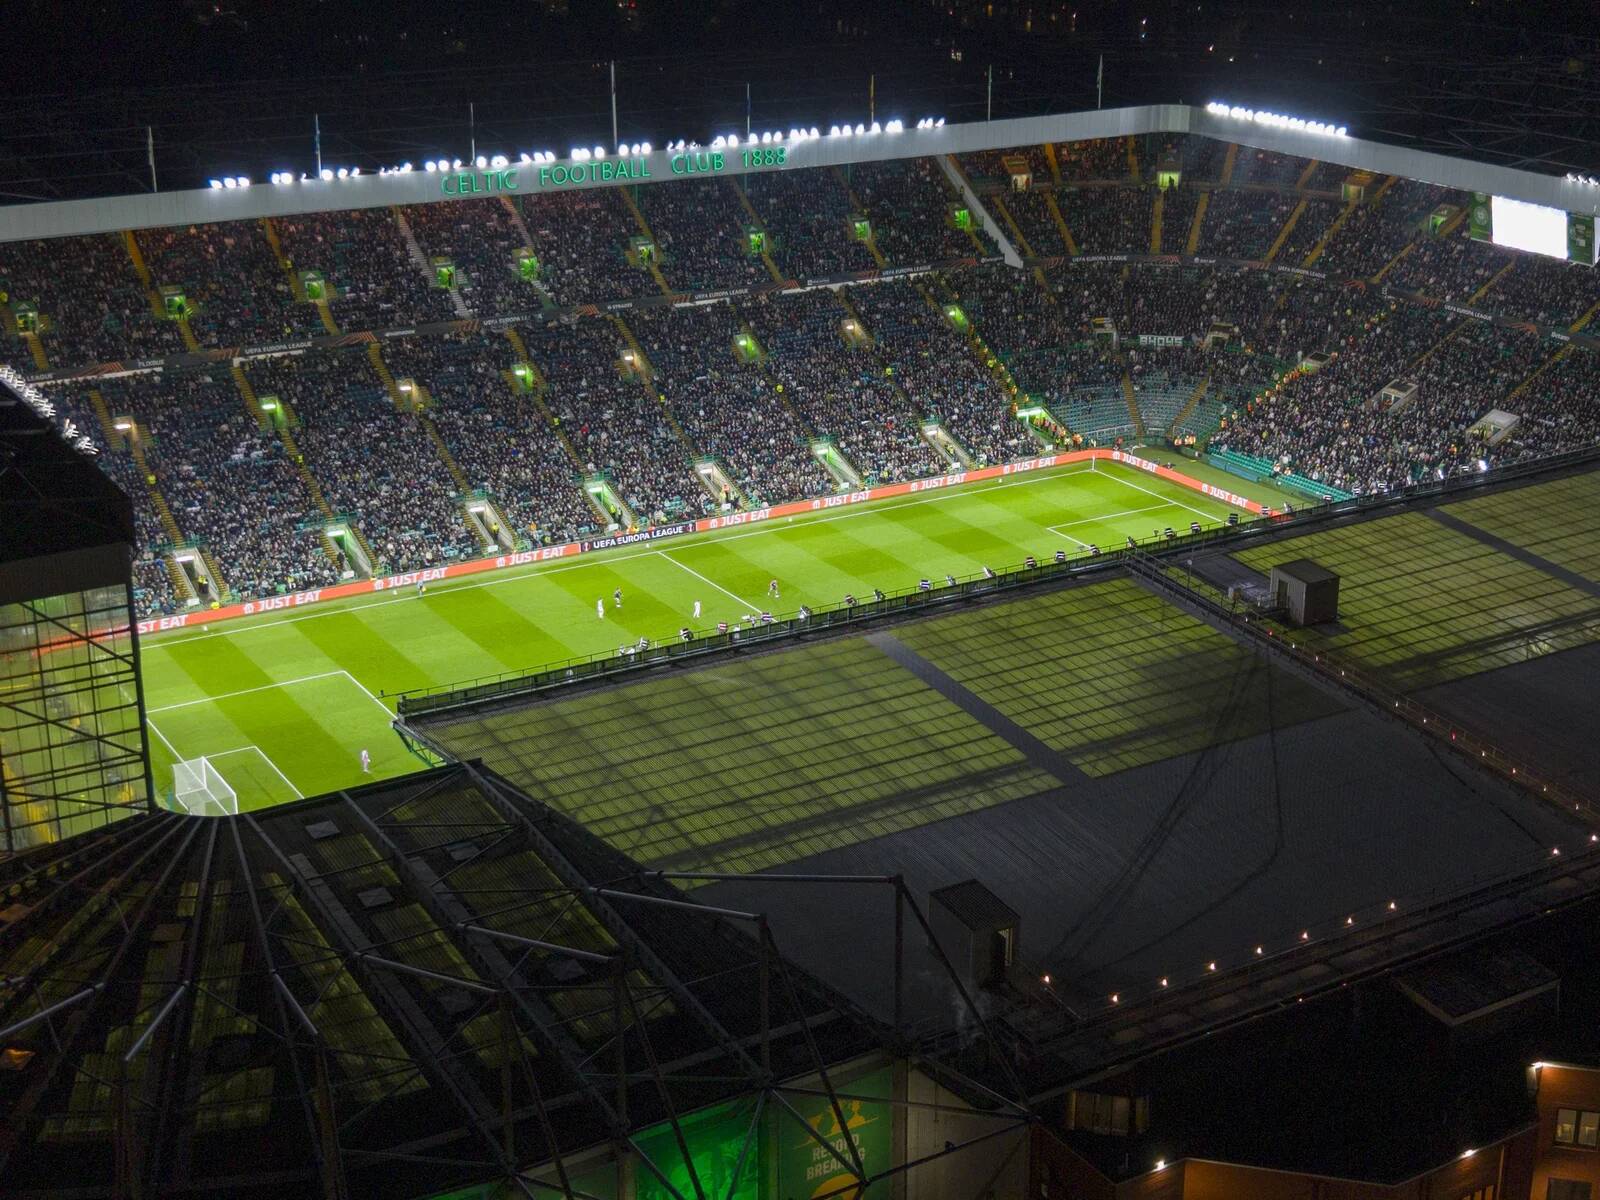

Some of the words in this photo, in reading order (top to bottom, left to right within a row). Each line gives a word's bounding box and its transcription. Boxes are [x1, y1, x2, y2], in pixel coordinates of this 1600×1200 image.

[441, 168, 518, 194] CELTIC
[540, 157, 651, 185] FOOTBALL
[671, 152, 725, 174] CLUB
[742, 147, 787, 168] 1888
[1013, 459, 1037, 471] JUST
[1038, 456, 1057, 467] EAT
[1122, 453, 1143, 465] JUST
[1142, 459, 1158, 472] EAT
[920, 477, 945, 489] JUST
[947, 473, 967, 485] EAT
[824, 495, 849, 507] JUST
[851, 490, 872, 502] EAT
[1210, 486, 1232, 501] JUST
[1231, 494, 1249, 508] EAT
[720, 512, 746, 526] JUST
[751, 508, 771, 520] EAT
[593, 536, 617, 548] UEFA
[617, 532, 650, 545] EUROPA
[651, 526, 684, 538] LEAGUE
[509, 550, 540, 566] JUST
[543, 546, 567, 559] EAT
[388, 571, 420, 588] JUST
[419, 567, 449, 581] EAT
[258, 596, 295, 612] JUST
[295, 590, 322, 604] EAT
[160, 614, 189, 629] EAT
